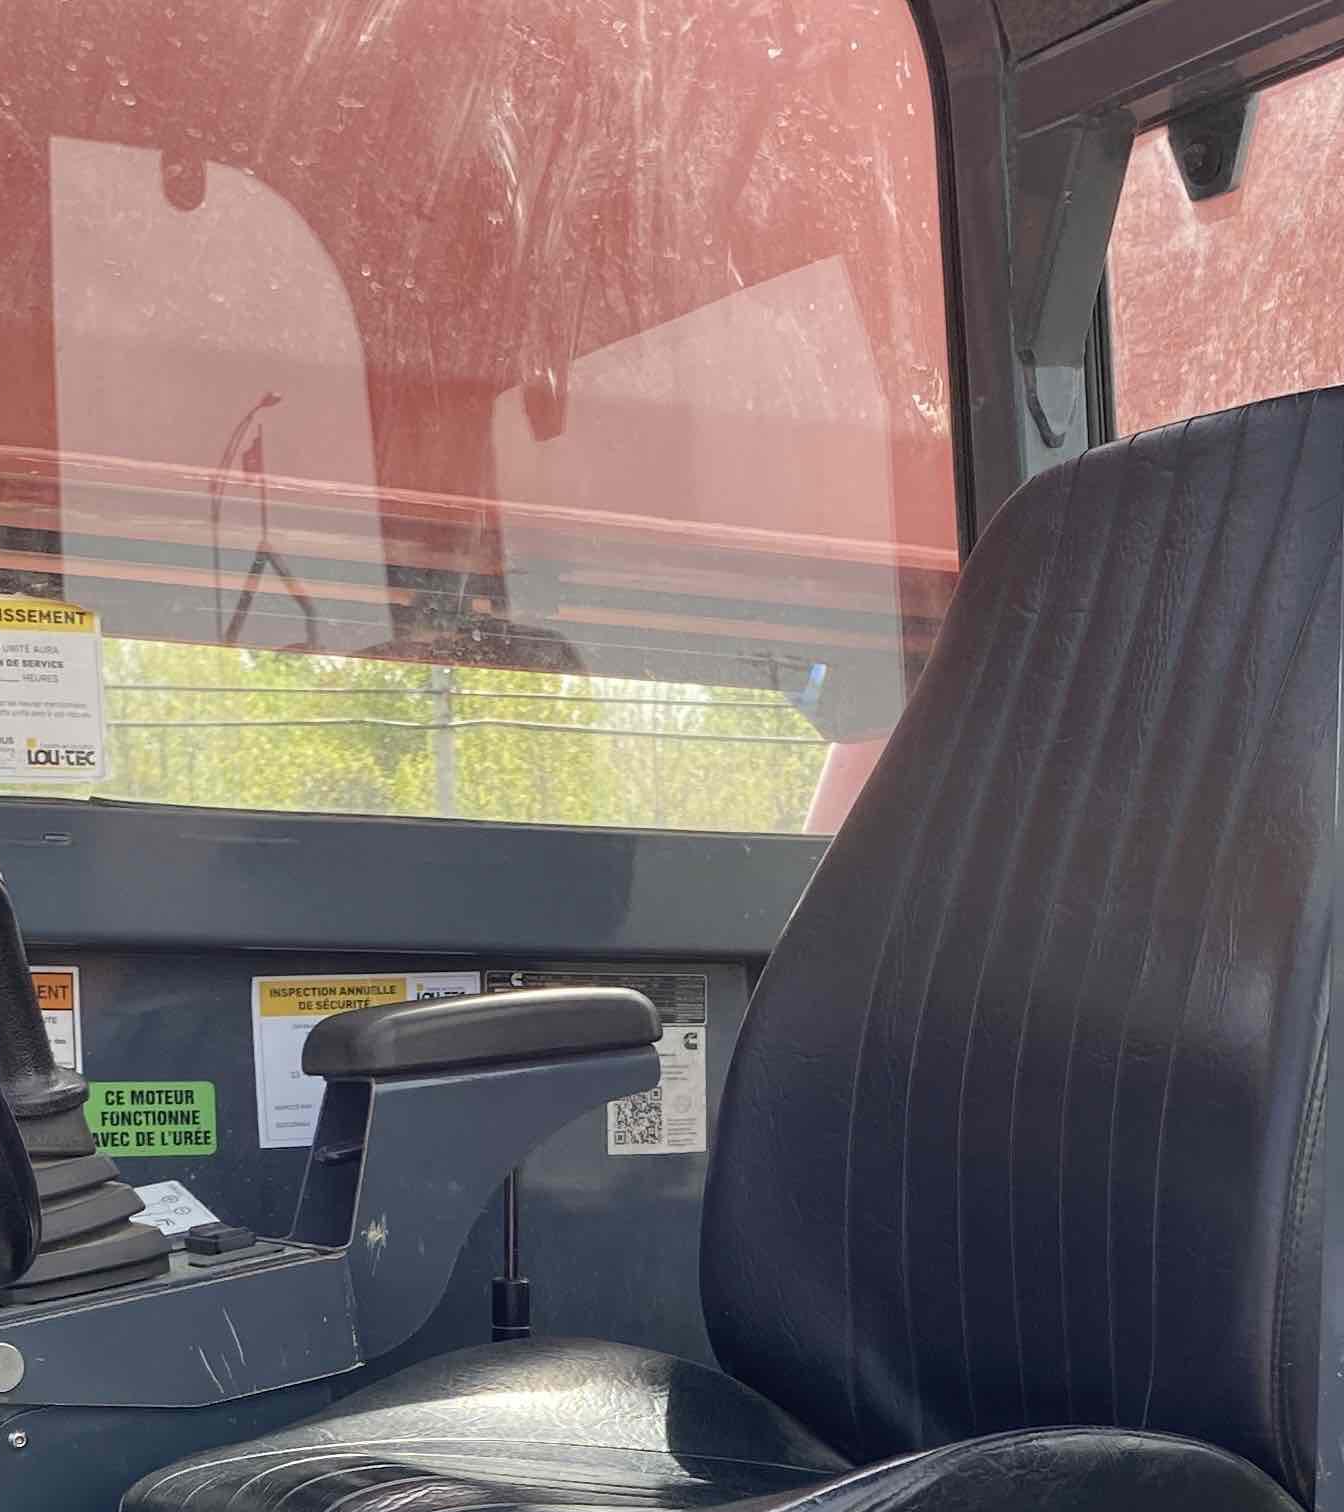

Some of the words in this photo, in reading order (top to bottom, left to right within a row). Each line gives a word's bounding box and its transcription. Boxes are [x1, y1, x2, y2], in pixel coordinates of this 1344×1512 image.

[6, 658, 20, 668] DE
[22, 659, 64, 669] SERVICE
[269, 986, 336, 998] INSPECTION
[339, 984, 397, 996] ANNUELLE
[298, 1000, 313, 1010] DE
[316, 998, 370, 1011] SÉCURITÉ
[105, 1090, 125, 1105] CE
[131, 1089, 195, 1105] MOTEUR
[101, 1110, 201, 1126] FONCTIONNE
[92, 1132, 130, 1147] AVEC
[136, 1131, 154, 1146] DE
